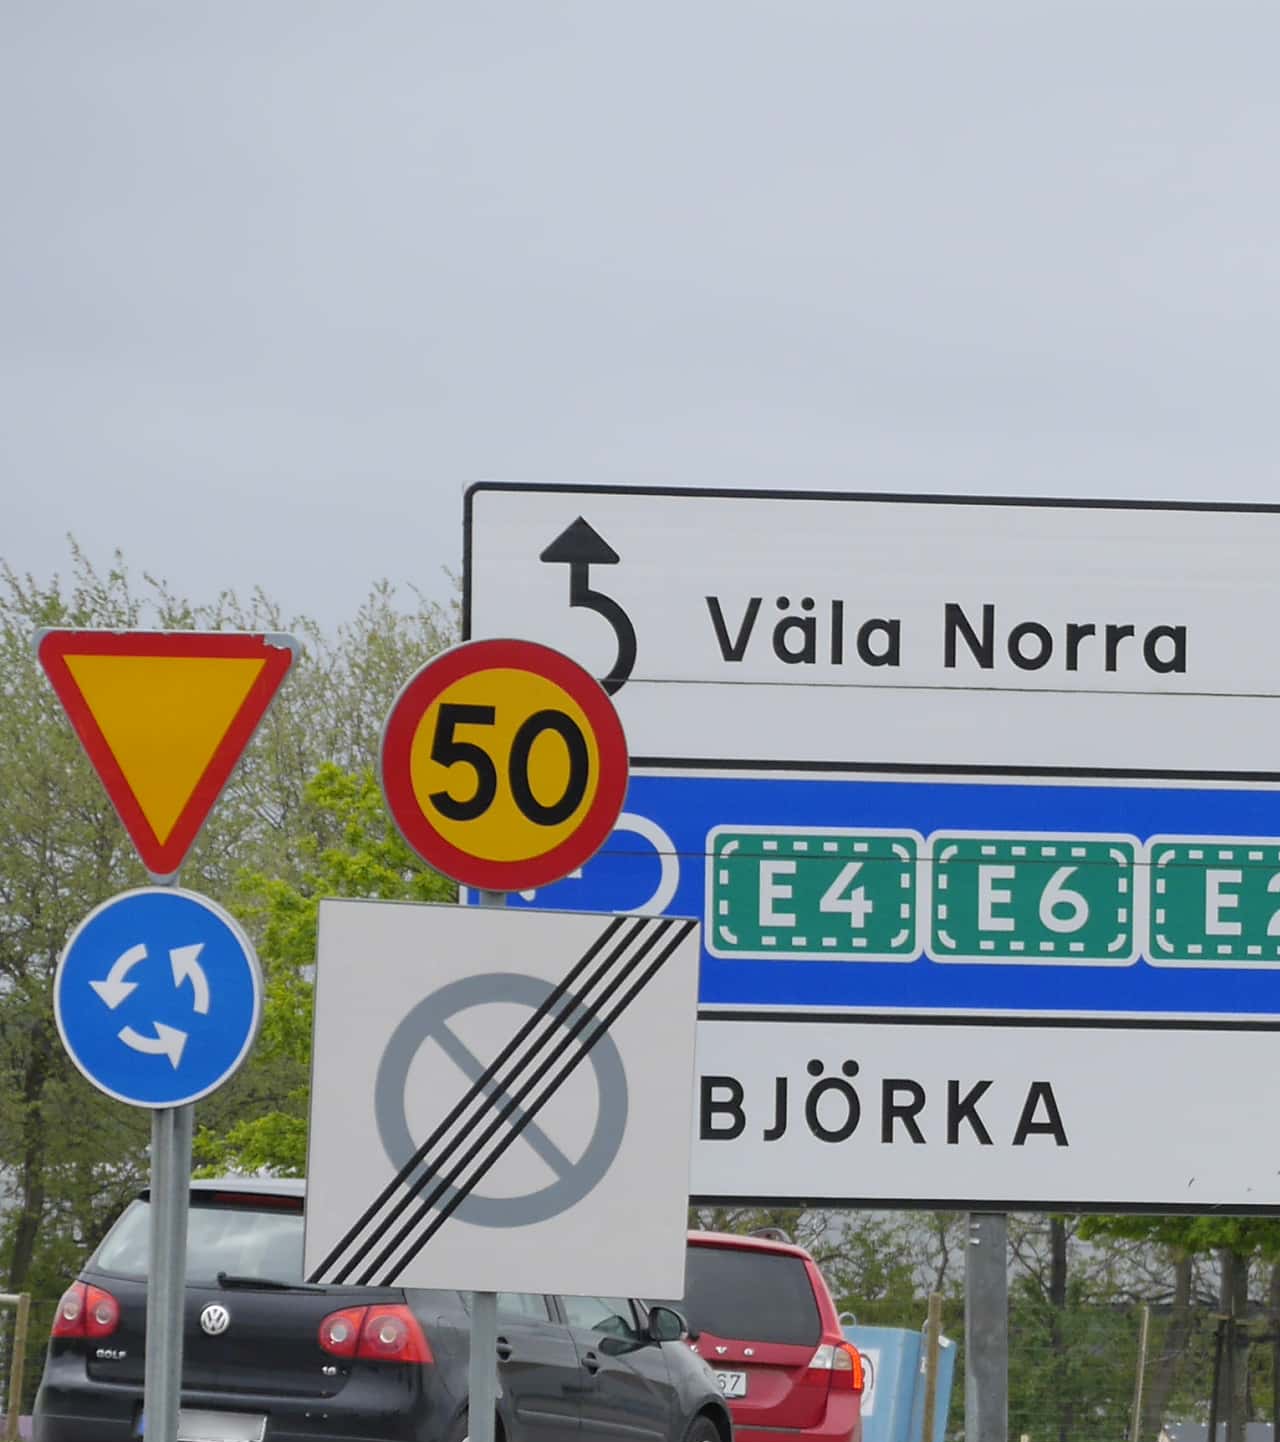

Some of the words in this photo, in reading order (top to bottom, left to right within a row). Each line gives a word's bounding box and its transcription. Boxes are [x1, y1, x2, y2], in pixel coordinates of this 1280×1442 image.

[705, 596, 902, 667] Väla
[943, 603, 1188, 674] Norra
[429, 703, 589, 826] 50
[759, 860, 873, 928] E4
[978, 865, 1089, 933] E6
[700, 1058, 1069, 1147] BJÖRKA
[96, 1348, 127, 1360] GOLF
